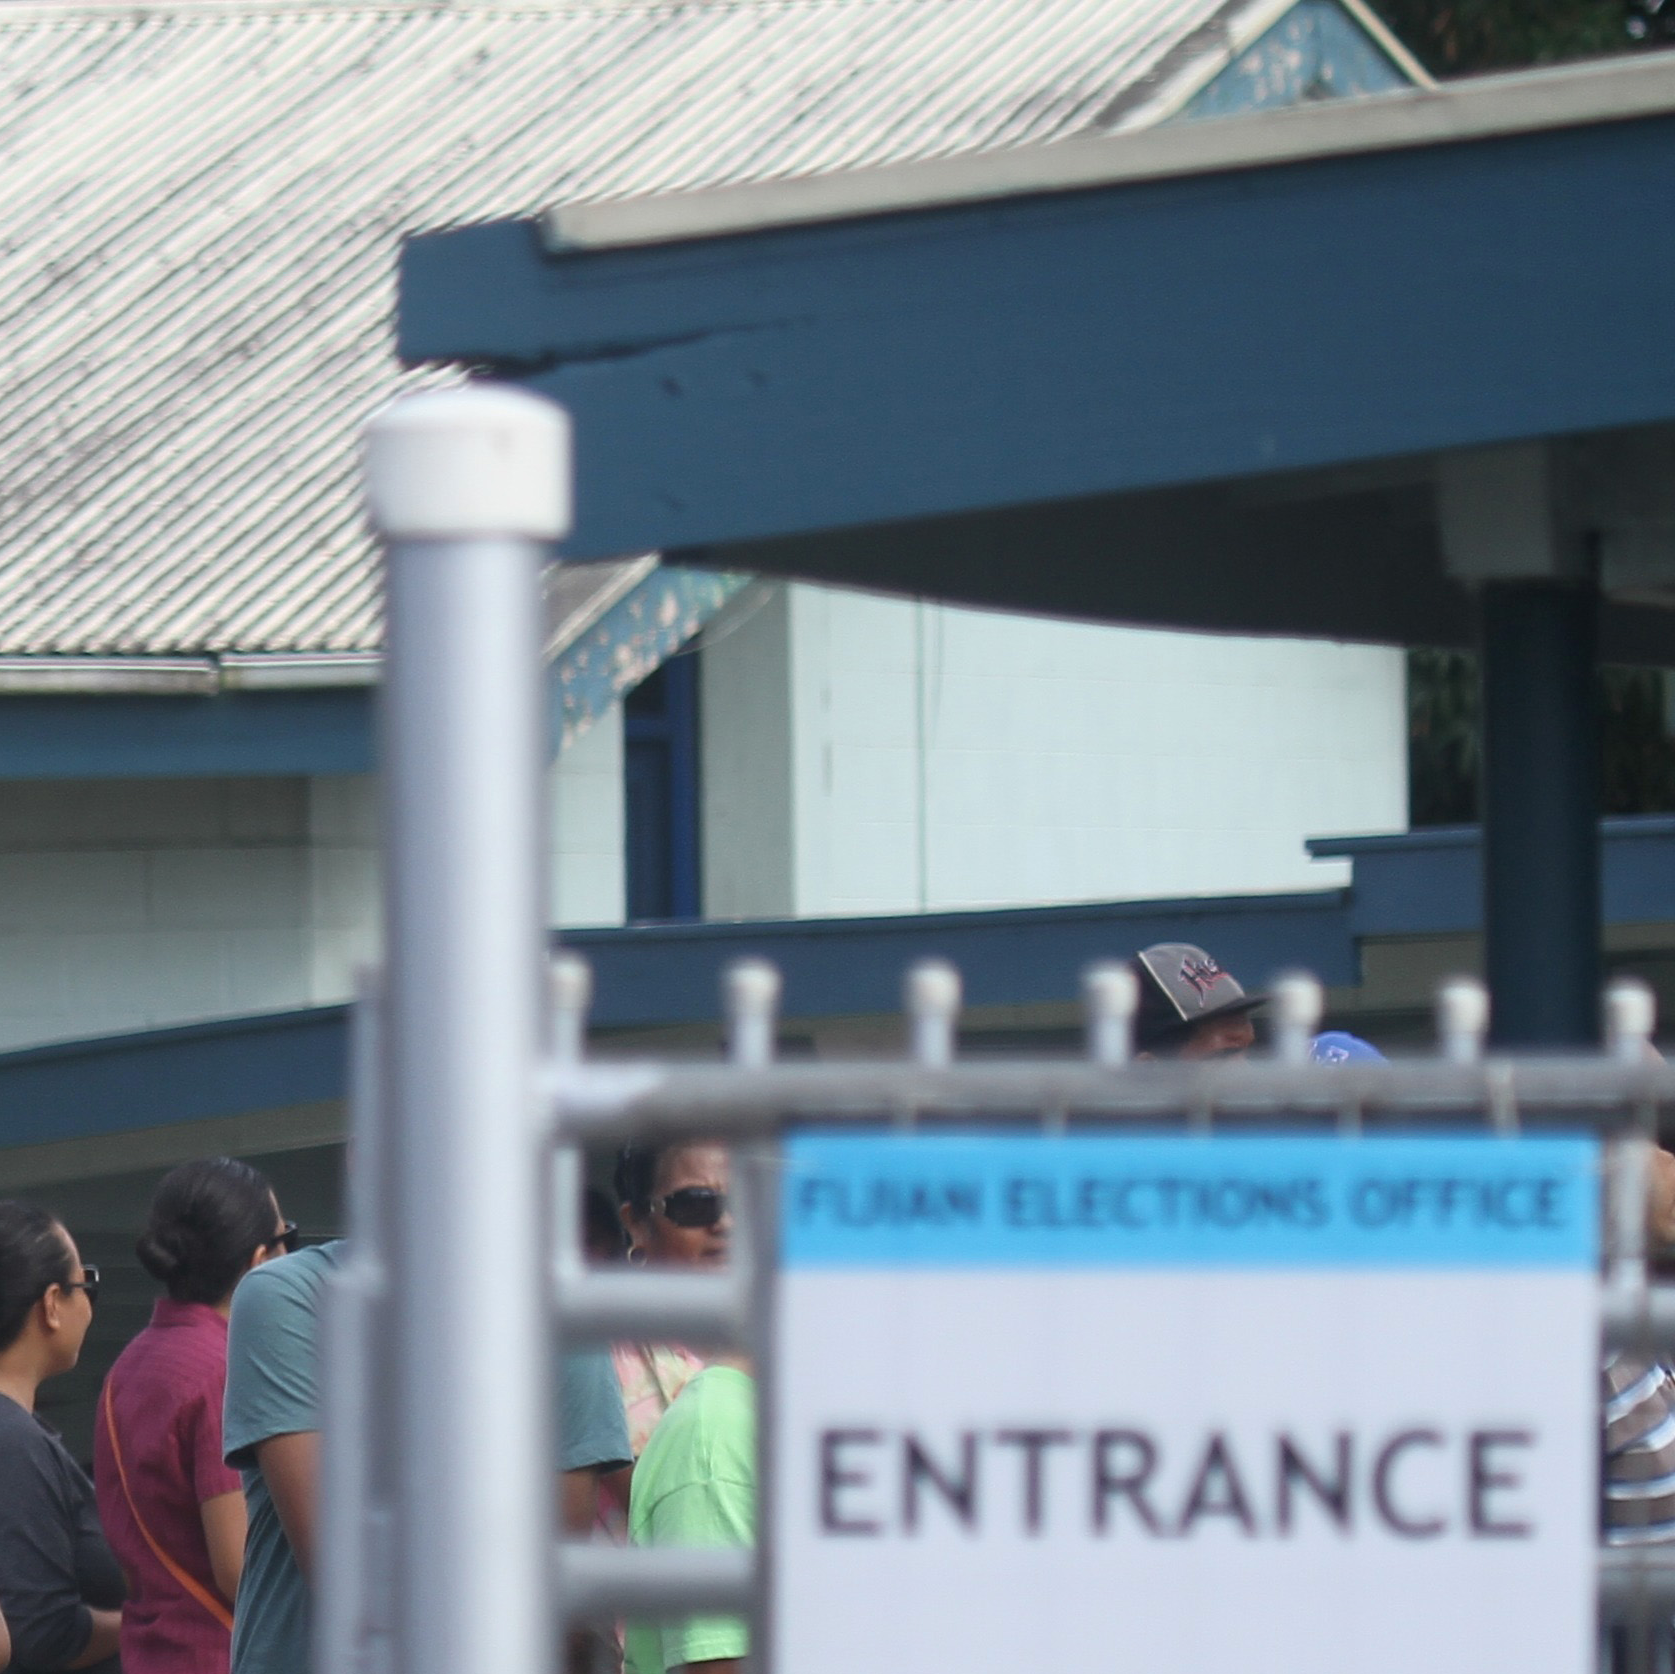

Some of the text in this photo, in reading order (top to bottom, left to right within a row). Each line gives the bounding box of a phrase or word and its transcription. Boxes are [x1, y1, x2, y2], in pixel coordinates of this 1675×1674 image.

[1004, 1176, 1329, 1230] ELECTIONS
[1348, 1176, 1567, 1230] OFFICE
[815, 1427, 1538, 1541] ENTRANCE
